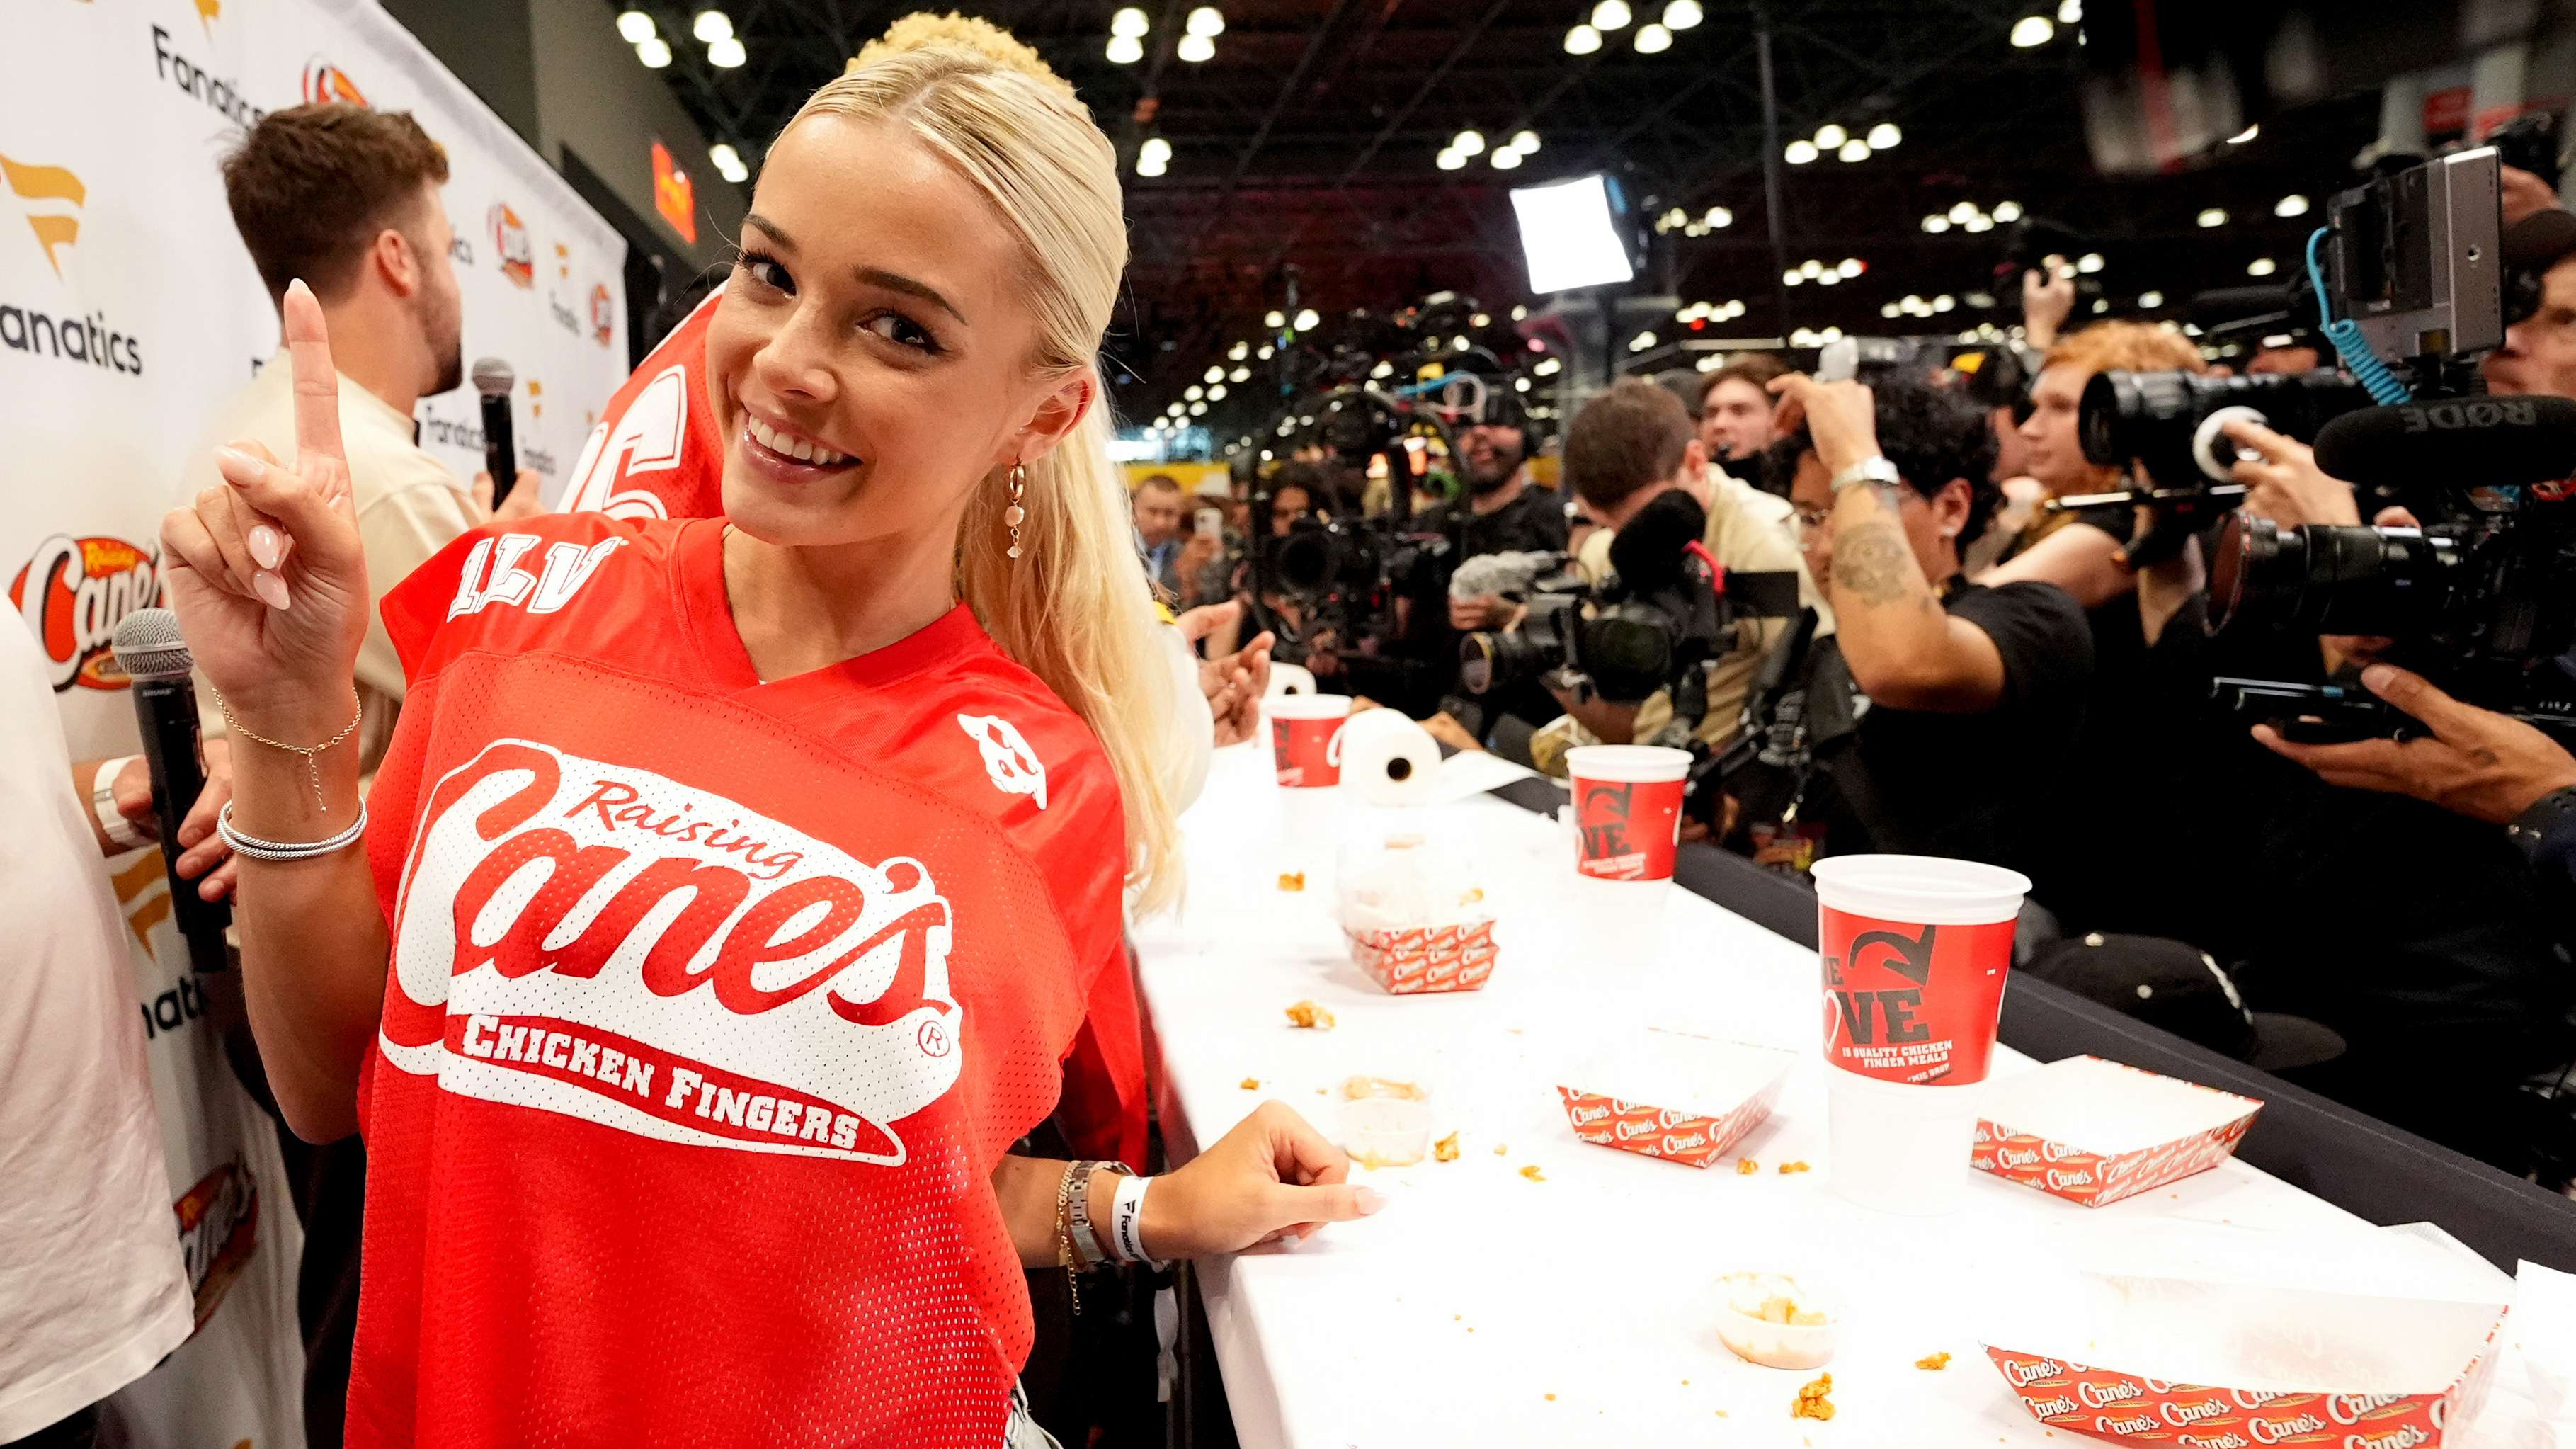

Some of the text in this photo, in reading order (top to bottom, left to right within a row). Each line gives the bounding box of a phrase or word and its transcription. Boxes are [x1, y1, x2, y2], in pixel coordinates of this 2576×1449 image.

[564, 779, 805, 880] Raising
[380, 744, 952, 1048] Cane's
[1853, 1047, 1898, 1058] QUALITY
[1901, 1040, 1953, 1057] CHICKEN
[1864, 1050, 1948, 1068] FINGER MEALS
[462, 1013, 860, 1151] CHICKEN FINGERS
[2003, 1358, 2064, 1387] Cane's
[2021, 1394, 2080, 1422] Cane's
[2078, 1379, 2144, 1409] Cane's
[2160, 1397, 2233, 1427] Cane's
[2247, 1412, 2327, 1444] Cane's
